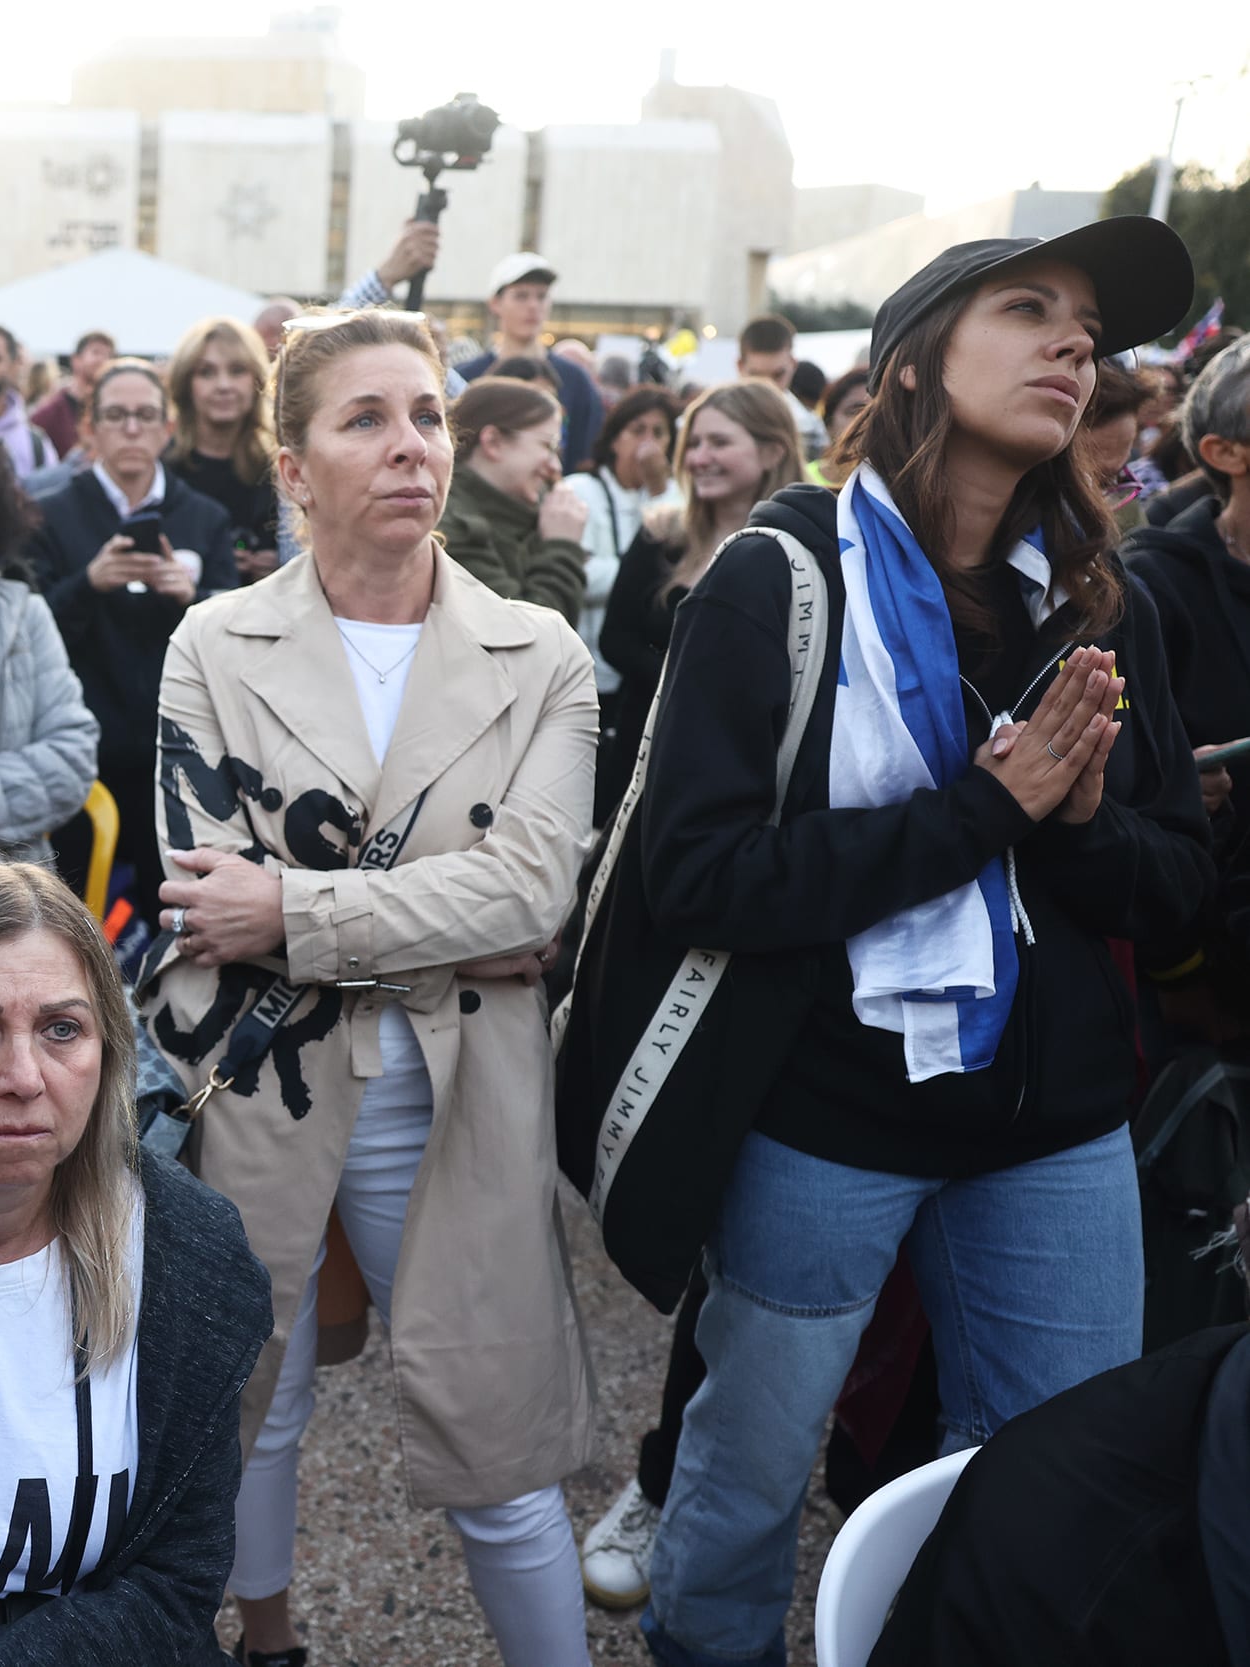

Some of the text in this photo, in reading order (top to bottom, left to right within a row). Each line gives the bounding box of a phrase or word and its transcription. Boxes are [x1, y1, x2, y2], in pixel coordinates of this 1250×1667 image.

[361, 827, 400, 870] RS
[601, 951, 717, 1160] FAIRLY JIMMY
